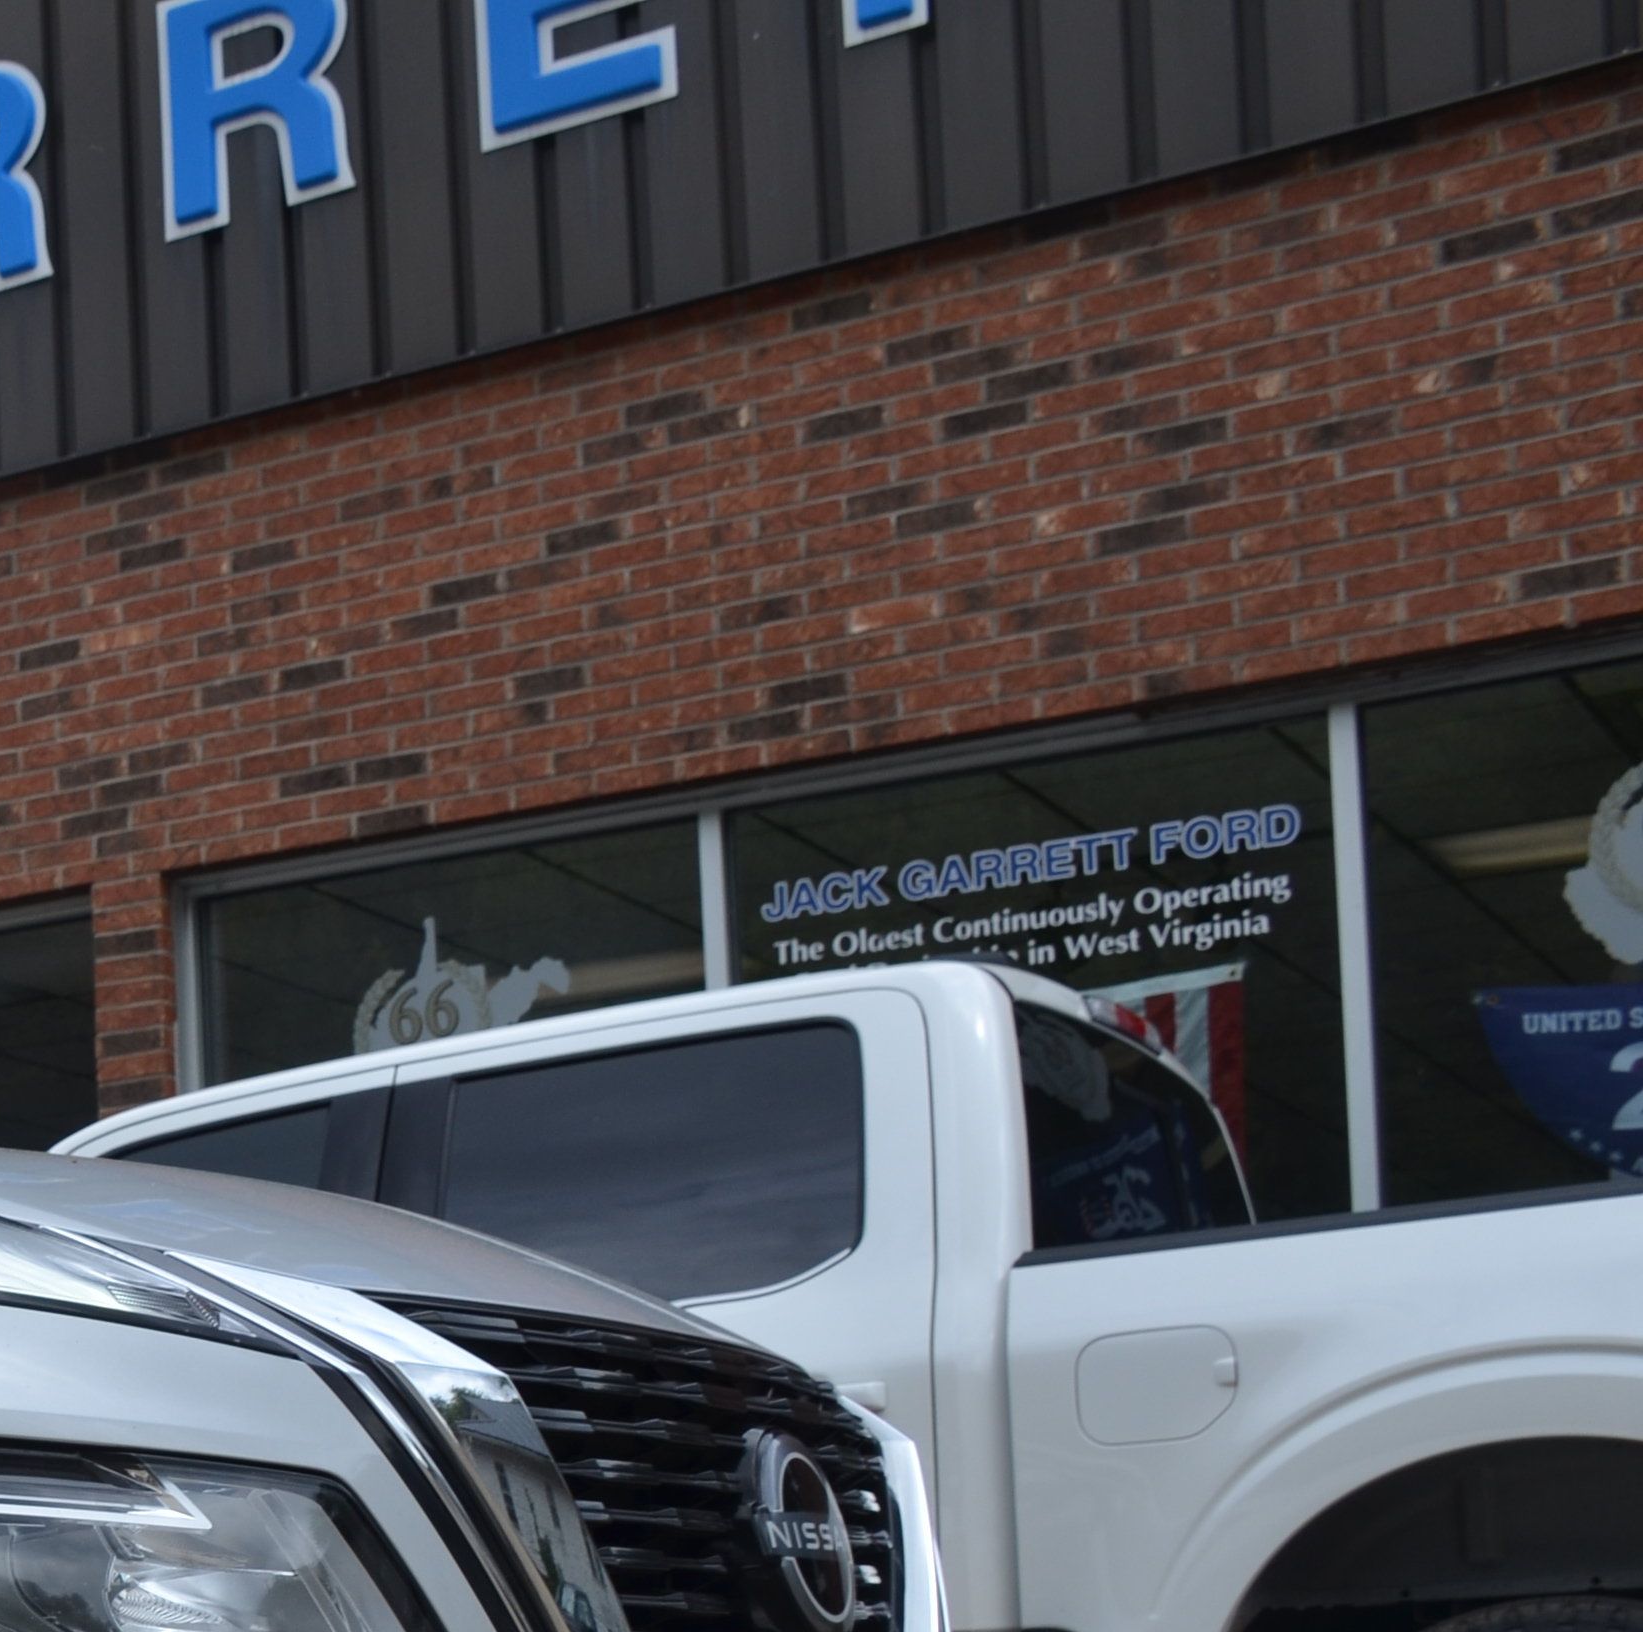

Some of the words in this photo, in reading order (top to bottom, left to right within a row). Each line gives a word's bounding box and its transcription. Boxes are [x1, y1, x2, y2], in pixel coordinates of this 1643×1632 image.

[761, 866, 889, 922] JACK
[899, 827, 1138, 900] GARRETT
[1150, 803, 1301, 865] FORD
[774, 938, 824, 965] The
[832, 923, 924, 956] Oldest
[933, 892, 1124, 943] Continuously
[1133, 871, 1292, 919] Operating
[1027, 939, 1056, 966] in
[1064, 929, 1140, 960] West
[1148, 909, 1270, 950] Virginia
[388, 979, 459, 1046] 66
[1522, 1008, 1622, 1034] UNITED
